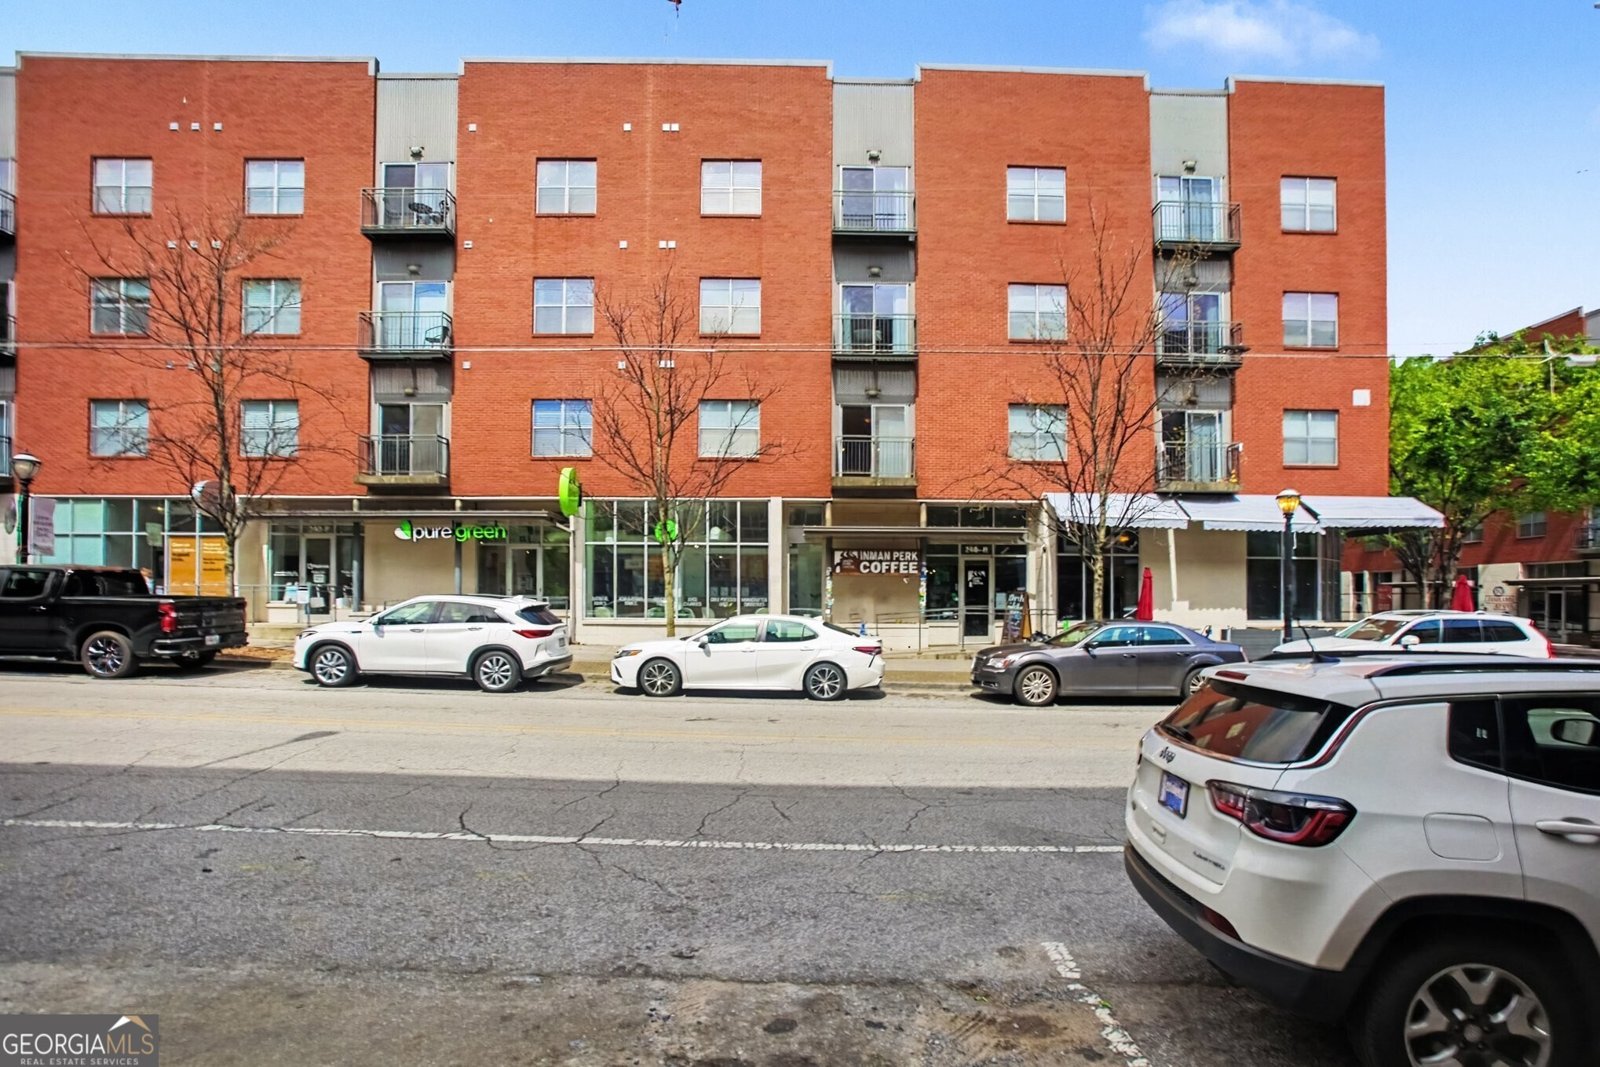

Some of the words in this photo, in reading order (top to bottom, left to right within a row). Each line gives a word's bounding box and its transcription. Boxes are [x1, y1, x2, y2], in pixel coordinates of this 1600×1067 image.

[412, 527, 452, 543] pure
[455, 526, 506, 542] green
[860, 551, 891, 561] INMAN
[893, 551, 919, 561] PERK
[860, 561, 919, 574] COFFEE
